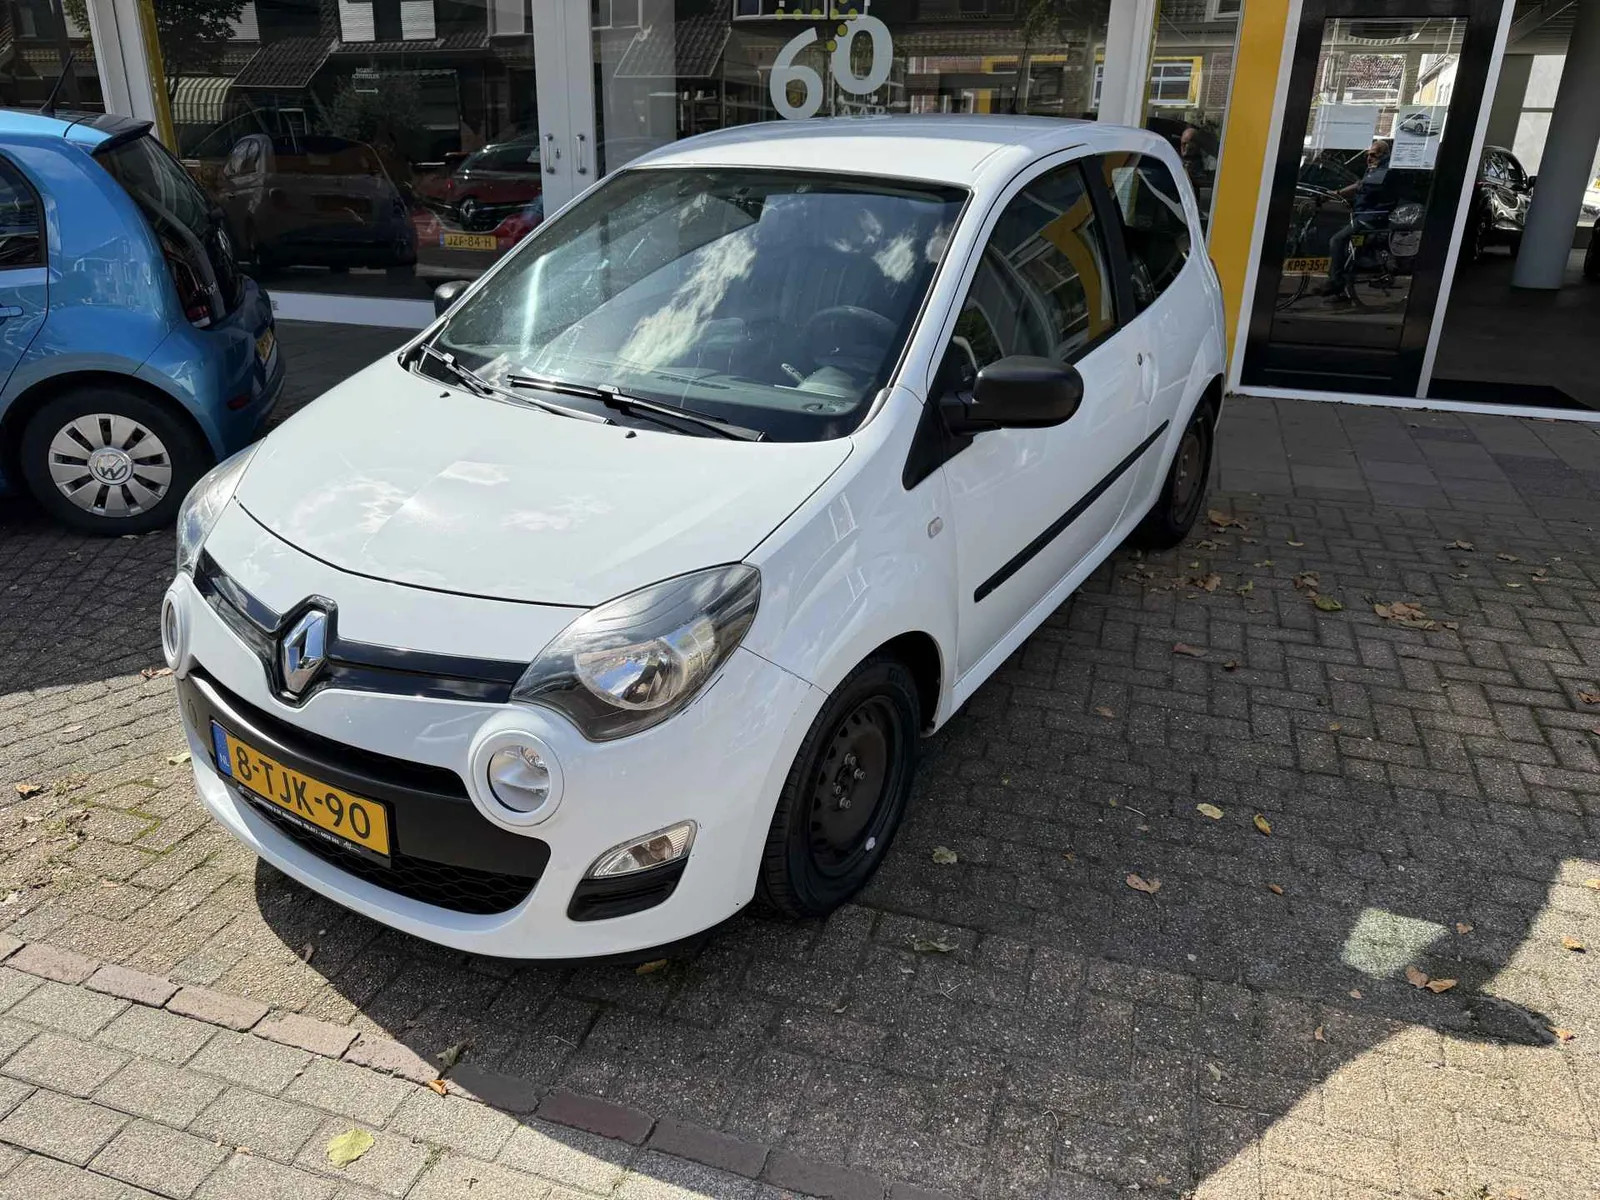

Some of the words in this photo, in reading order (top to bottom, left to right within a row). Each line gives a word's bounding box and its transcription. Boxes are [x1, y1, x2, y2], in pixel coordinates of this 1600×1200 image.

[447, 235, 492, 248] JZF-84-H
[219, 753, 230, 767] NL
[235, 746, 371, 840] 8-TJK-90
